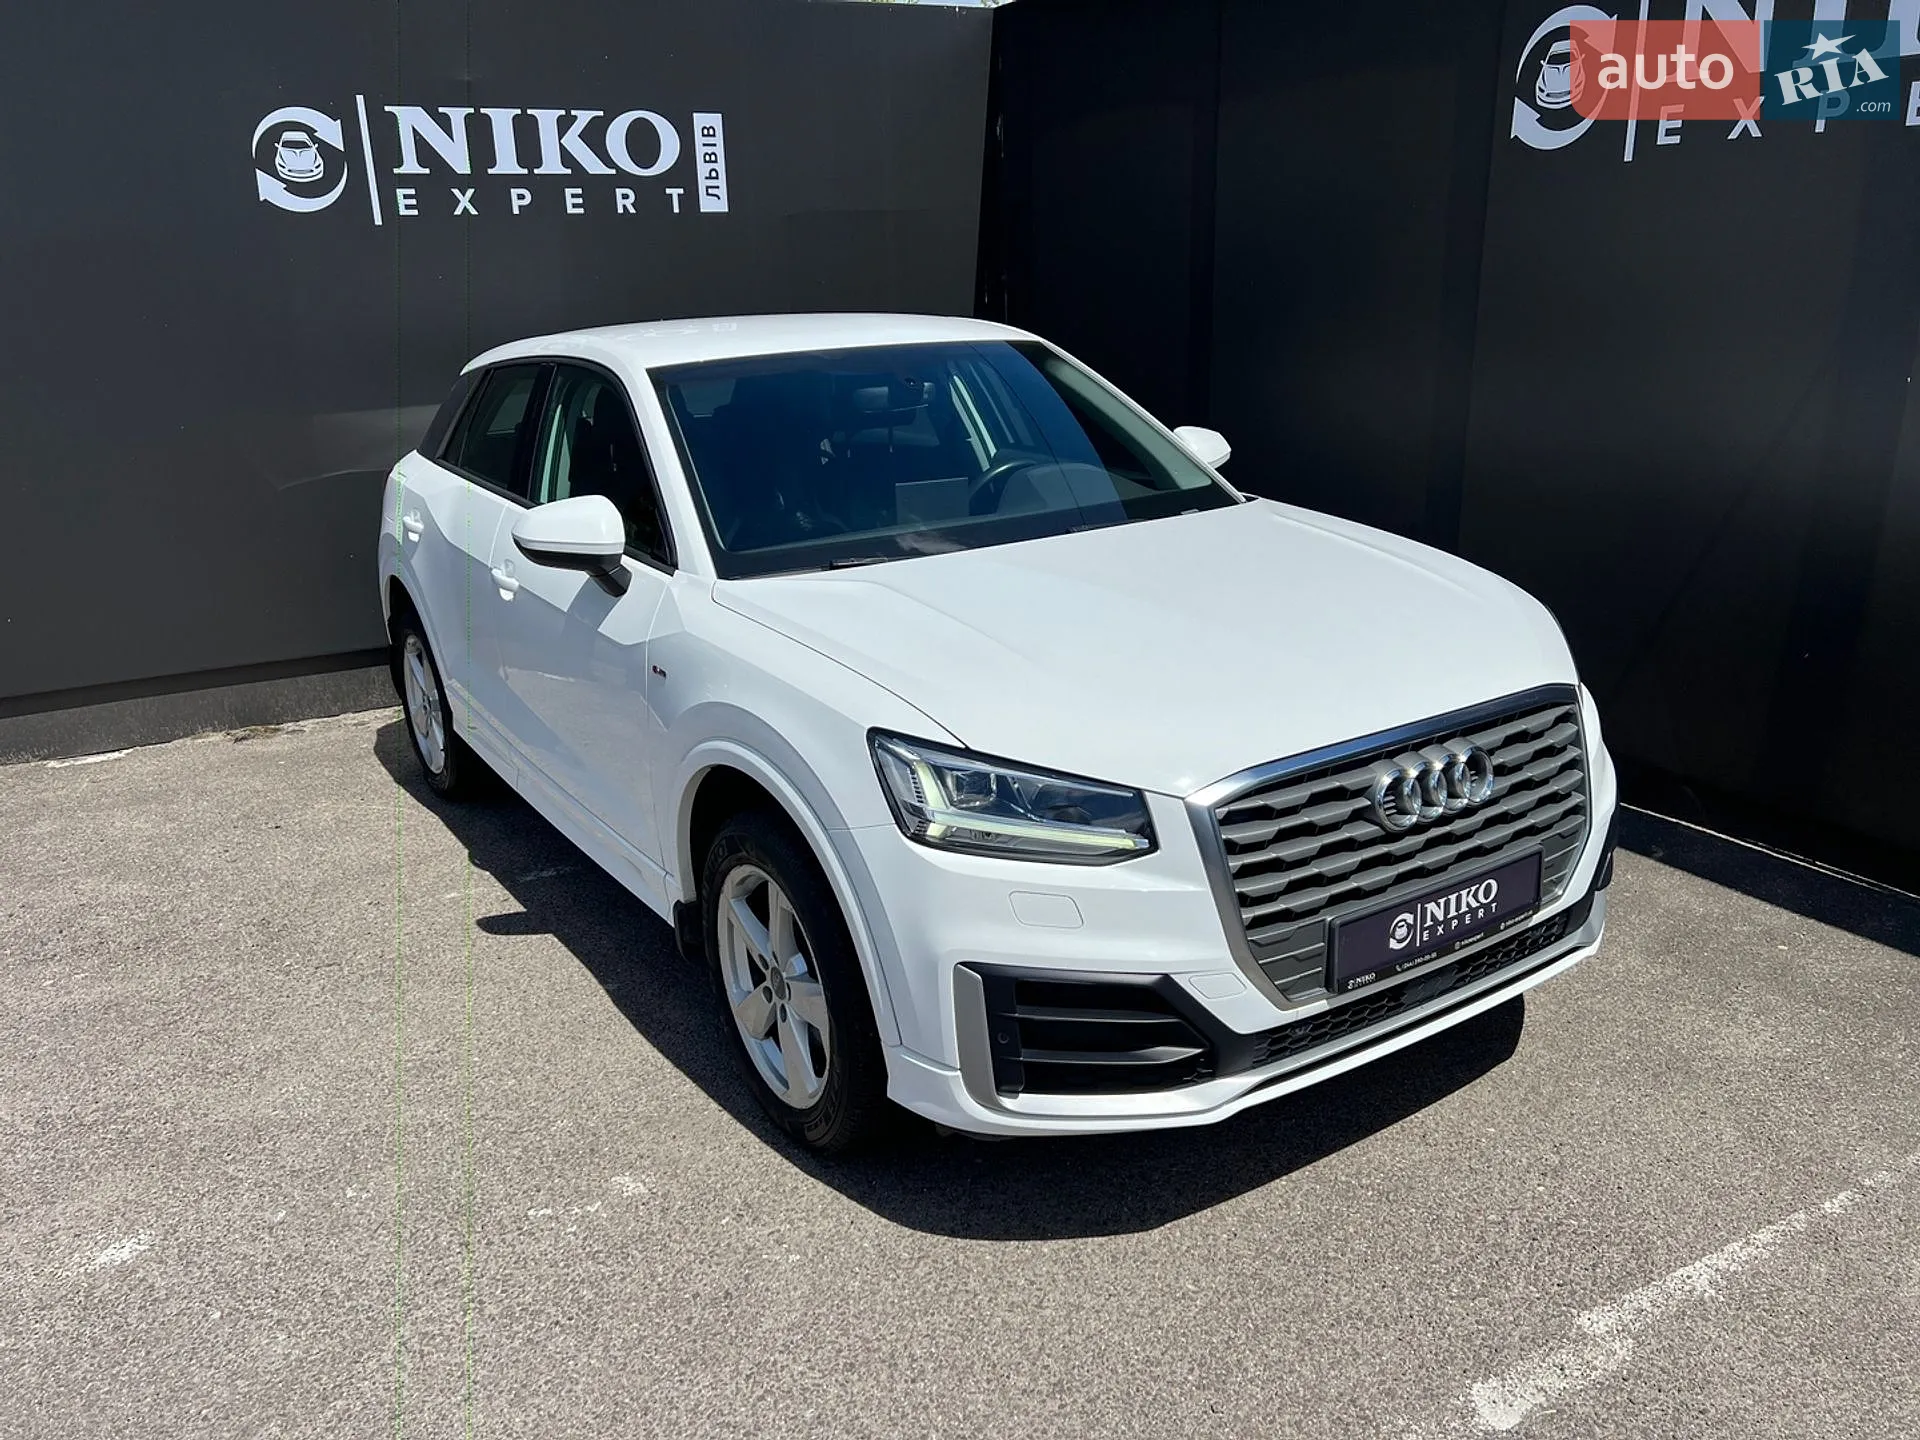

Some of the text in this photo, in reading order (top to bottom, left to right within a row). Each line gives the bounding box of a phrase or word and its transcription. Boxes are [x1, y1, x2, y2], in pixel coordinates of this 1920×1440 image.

[384, 105, 681, 176] NIKO
[700, 124, 722, 200] ЛЬВІВ
[396, 187, 684, 215] EXPERT
[1422, 902, 1497, 941] EXPERT
[1423, 879, 1498, 927] NIKO
